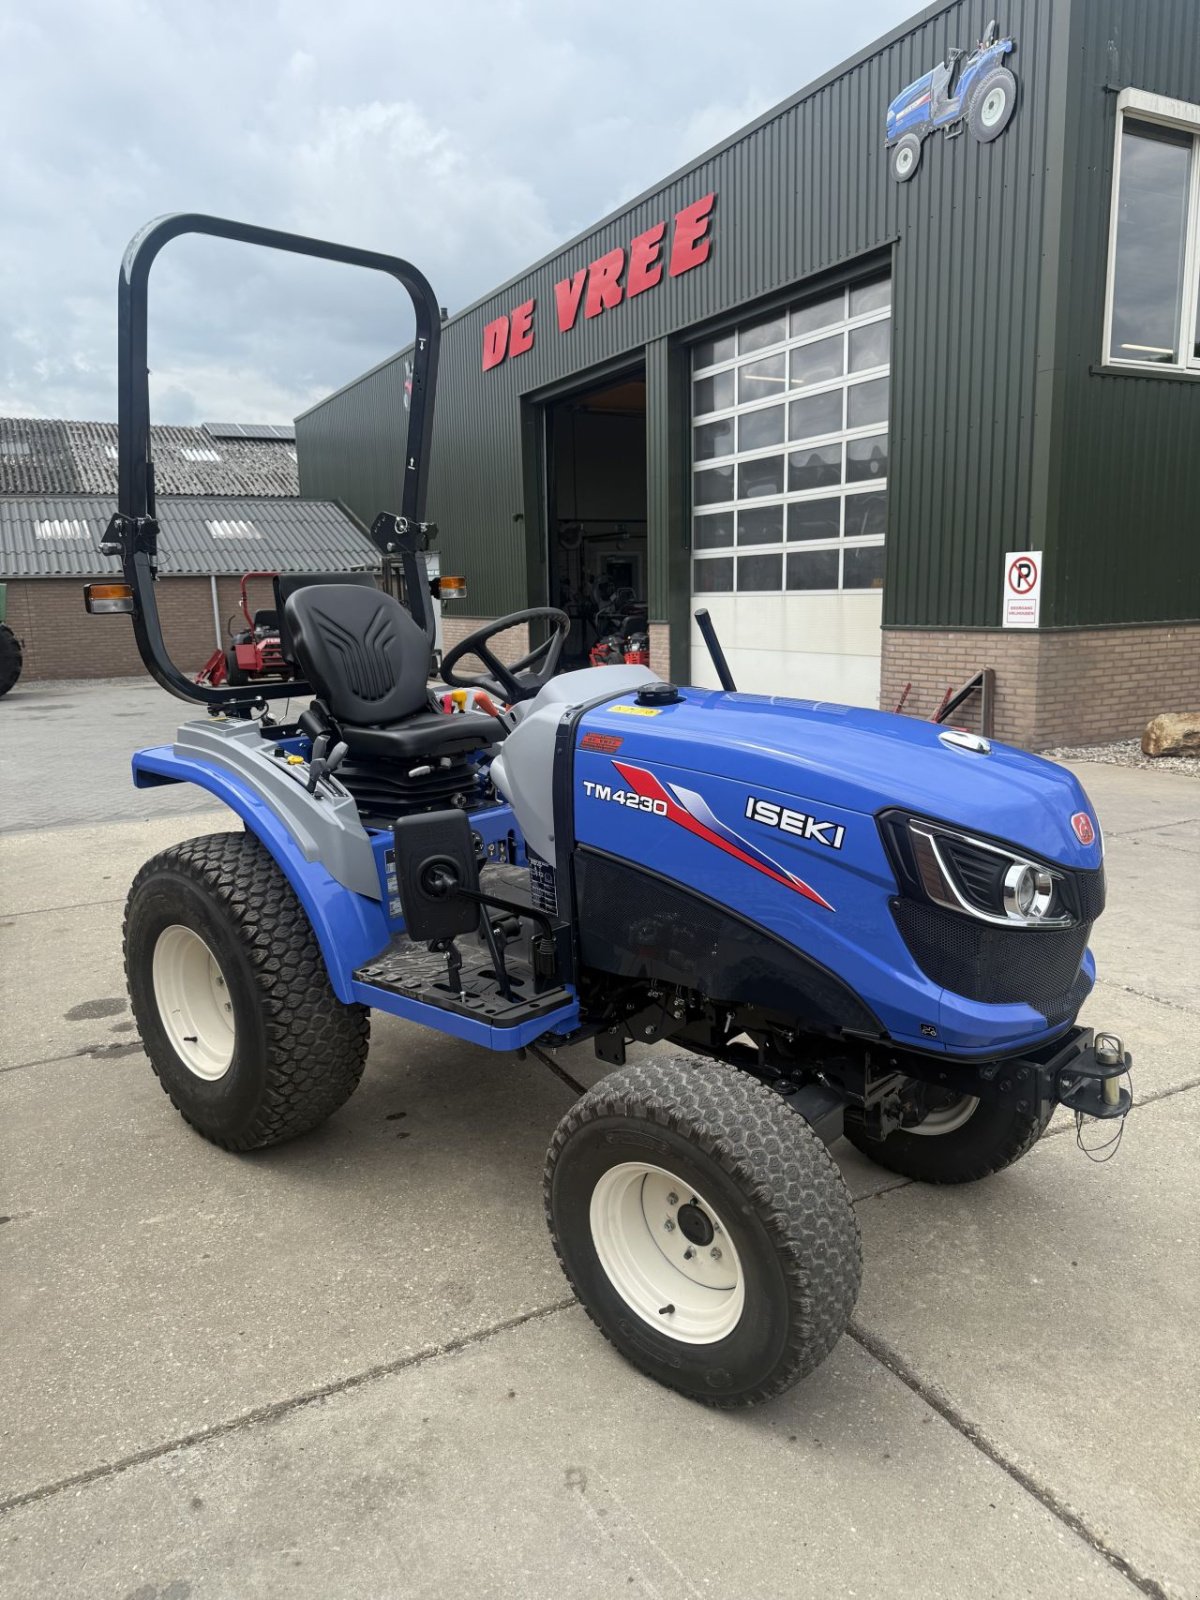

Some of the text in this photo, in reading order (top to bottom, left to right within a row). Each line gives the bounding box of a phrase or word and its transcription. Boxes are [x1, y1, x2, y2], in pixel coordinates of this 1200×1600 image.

[482, 192, 715, 372] DE VREE
[583, 780, 668, 816] TM4230
[745, 796, 846, 850] ISEKI
